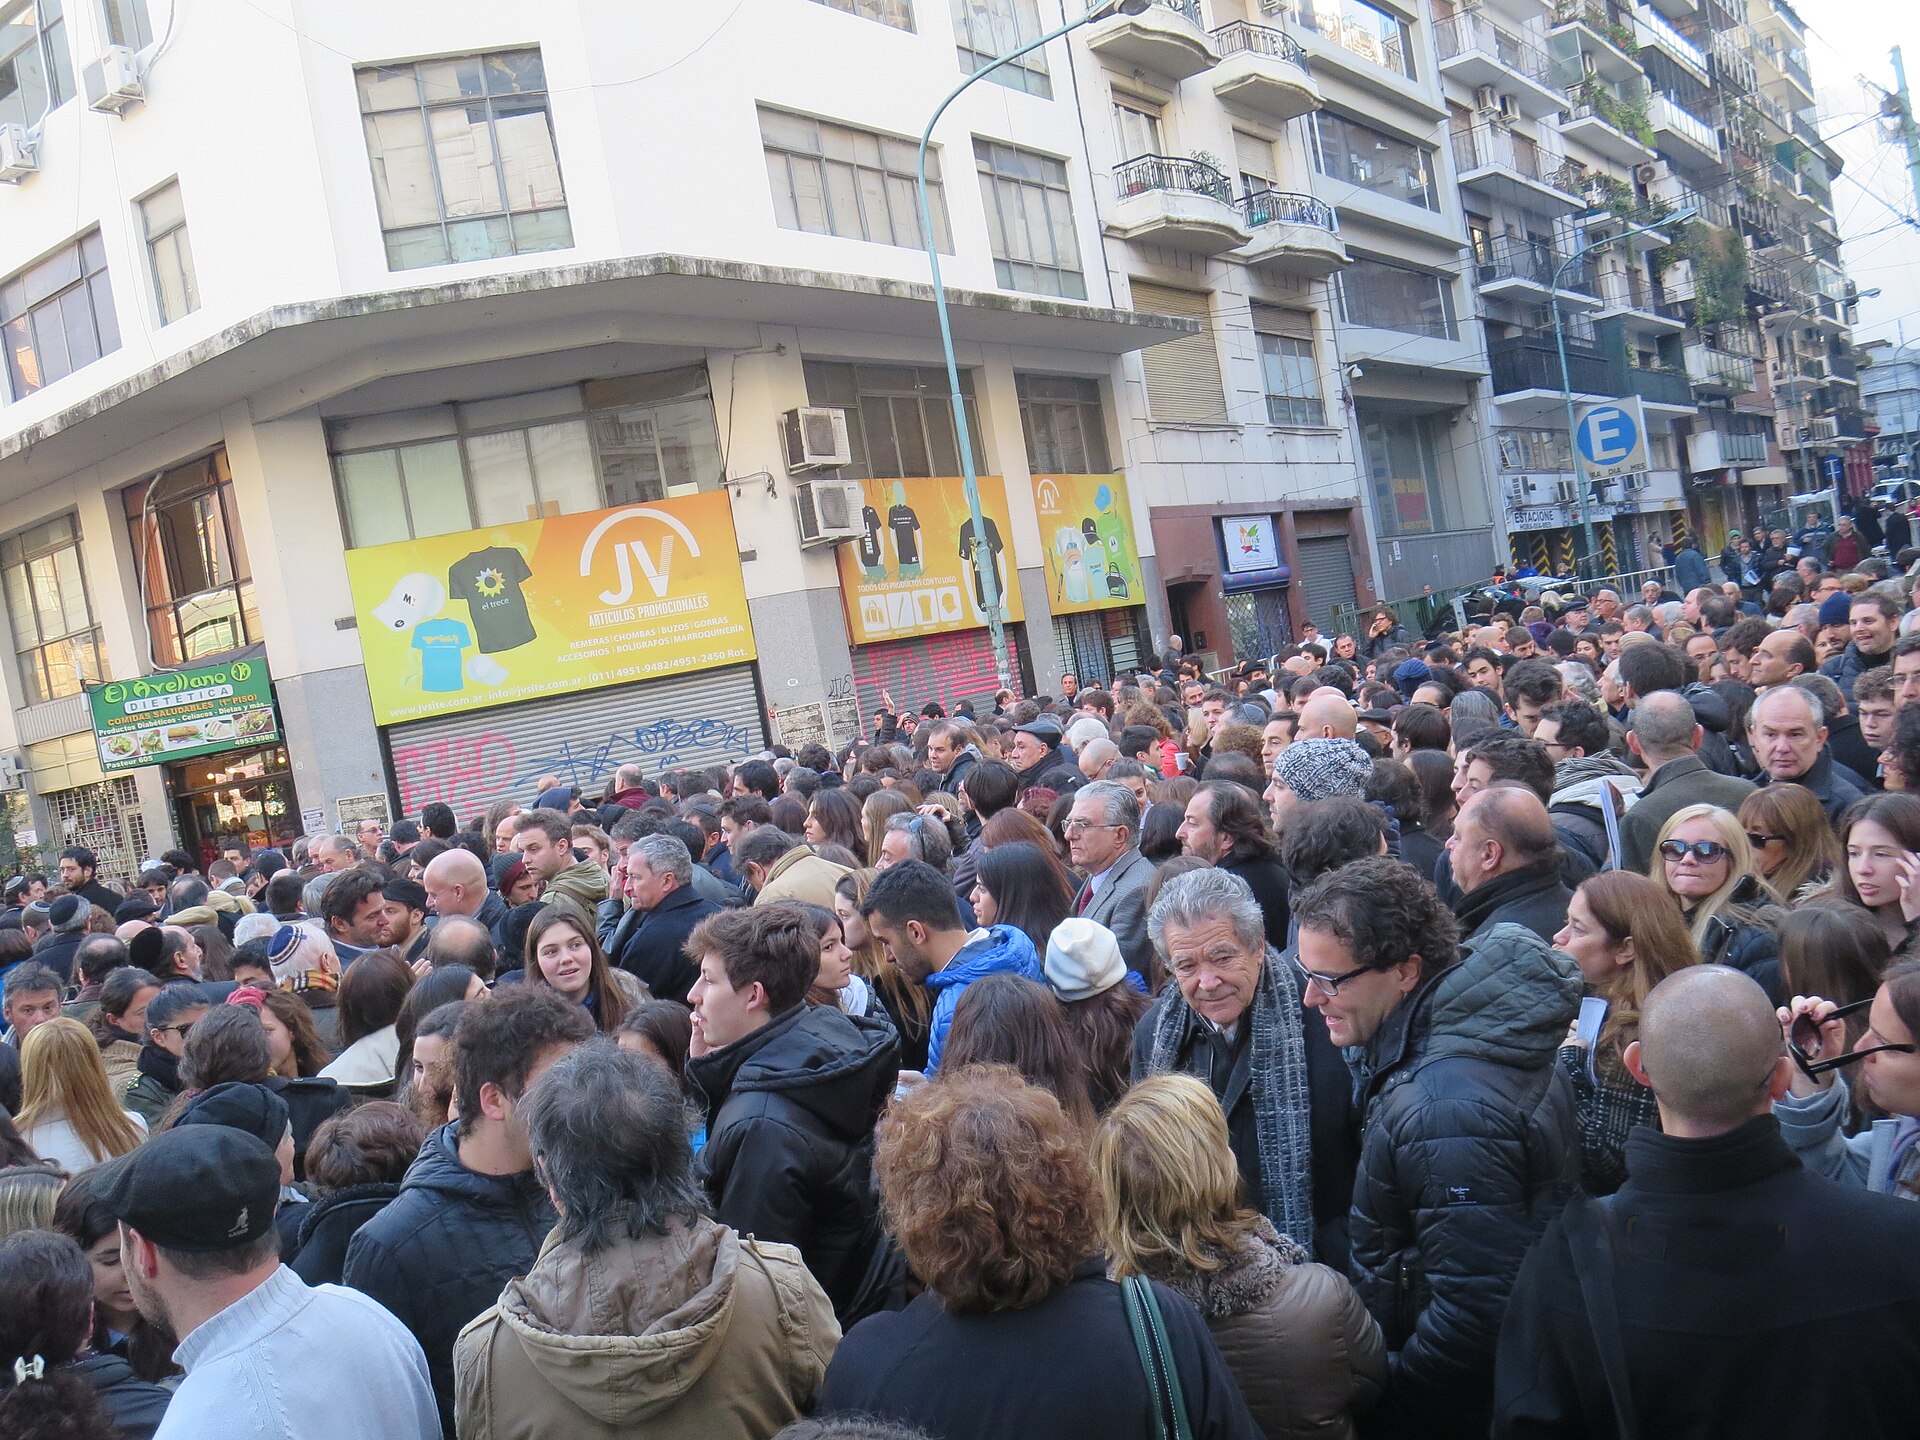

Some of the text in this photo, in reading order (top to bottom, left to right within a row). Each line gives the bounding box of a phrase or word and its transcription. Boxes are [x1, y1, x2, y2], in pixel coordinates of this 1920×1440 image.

[1588, 410, 1626, 462] E
[1608, 467, 1622, 475] DIA
[1631, 462, 1646, 470] MES
[598, 535, 674, 606] JV
[857, 576, 957, 593] TODOS LOS PRODUCTOS CON TU LOGO
[481, 598, 510, 611] el trece
[589, 596, 709, 628] ARTICULOS PROMOCIONALES
[557, 623, 745, 663] ACCESORIOS BOLÍGRAFOS MARROQUINERÍA
[570, 616, 729, 650] REMERAS CHOMBAS BUZOS GORRAS
[104, 671, 227, 704] El Avellano
[390, 647, 748, 717] www.jvsite.com.ar info@jvsite.com.ar (011) 4951-9482/4951-2450 Rot.
[99, 724, 136, 736] Productos
[137, 717, 177, 730] Diabéticos
[218, 706, 242, 714] Dietas
[107, 712, 151, 727] COMIDAS
[153, 702, 214, 719] SALUDABLES
[232, 694, 257, 704] PISO)
[106, 755, 154, 770] Pasteur 605
